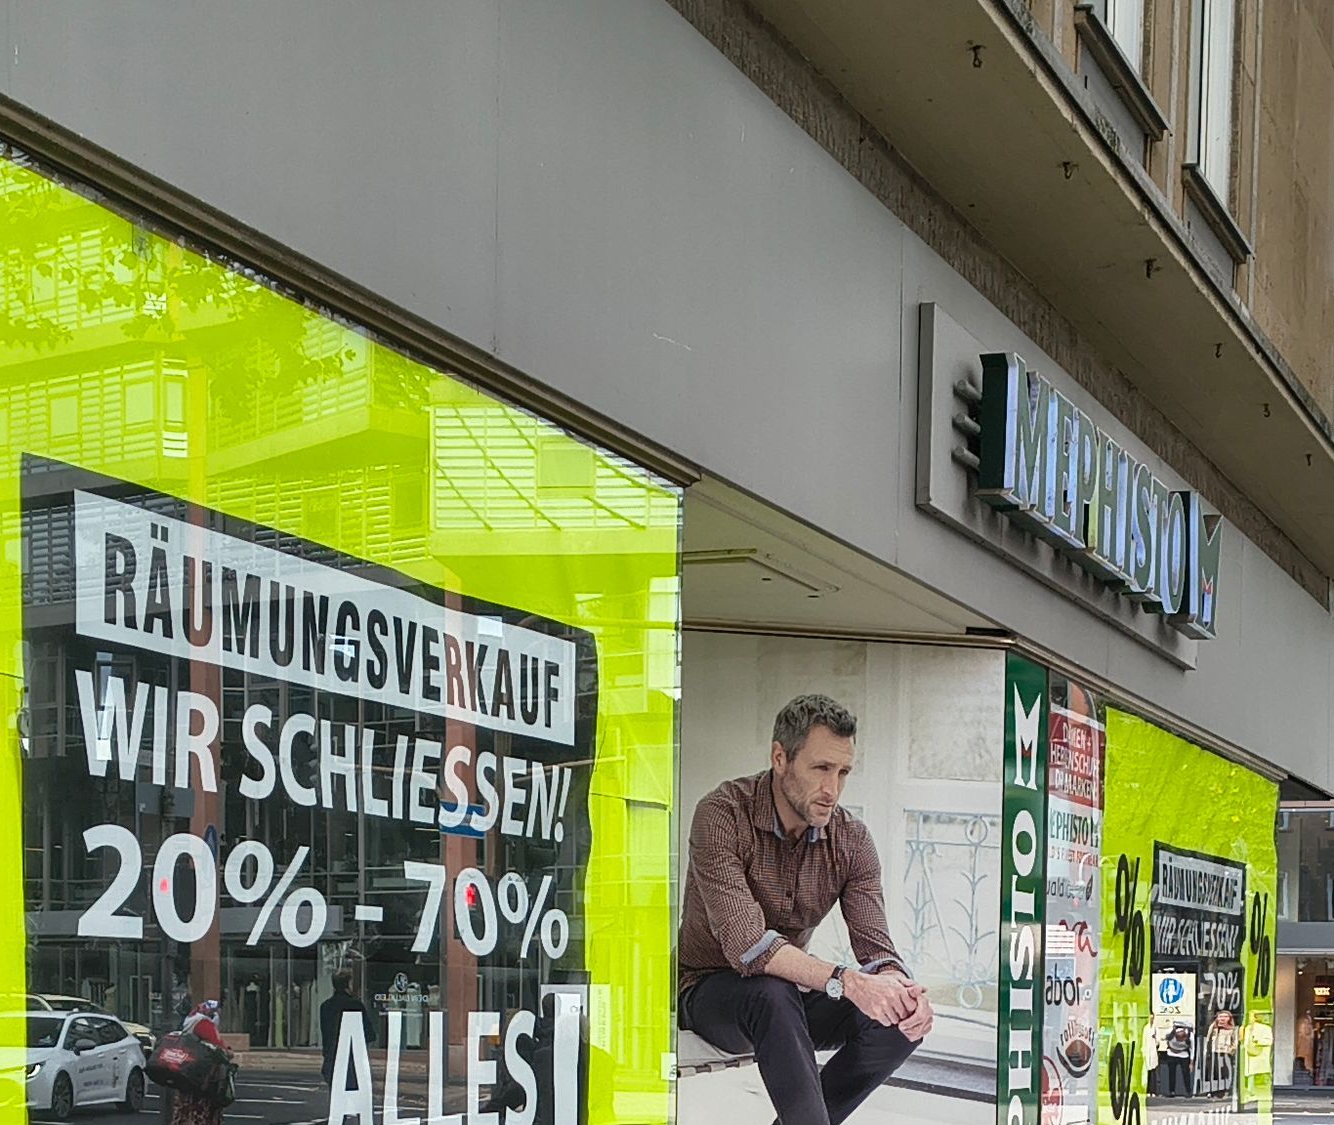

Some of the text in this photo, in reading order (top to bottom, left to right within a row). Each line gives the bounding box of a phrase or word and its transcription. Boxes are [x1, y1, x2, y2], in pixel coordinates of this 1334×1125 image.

[978, 352, 1184, 615] MEPHISTO
[104, 522, 560, 729] RÄUMUNGSVERKAUF
[75, 669, 572, 843] WIR SCHLIESSEN!
[77, 824, 327, 949] 20%
[403, 860, 568, 959] 70%
